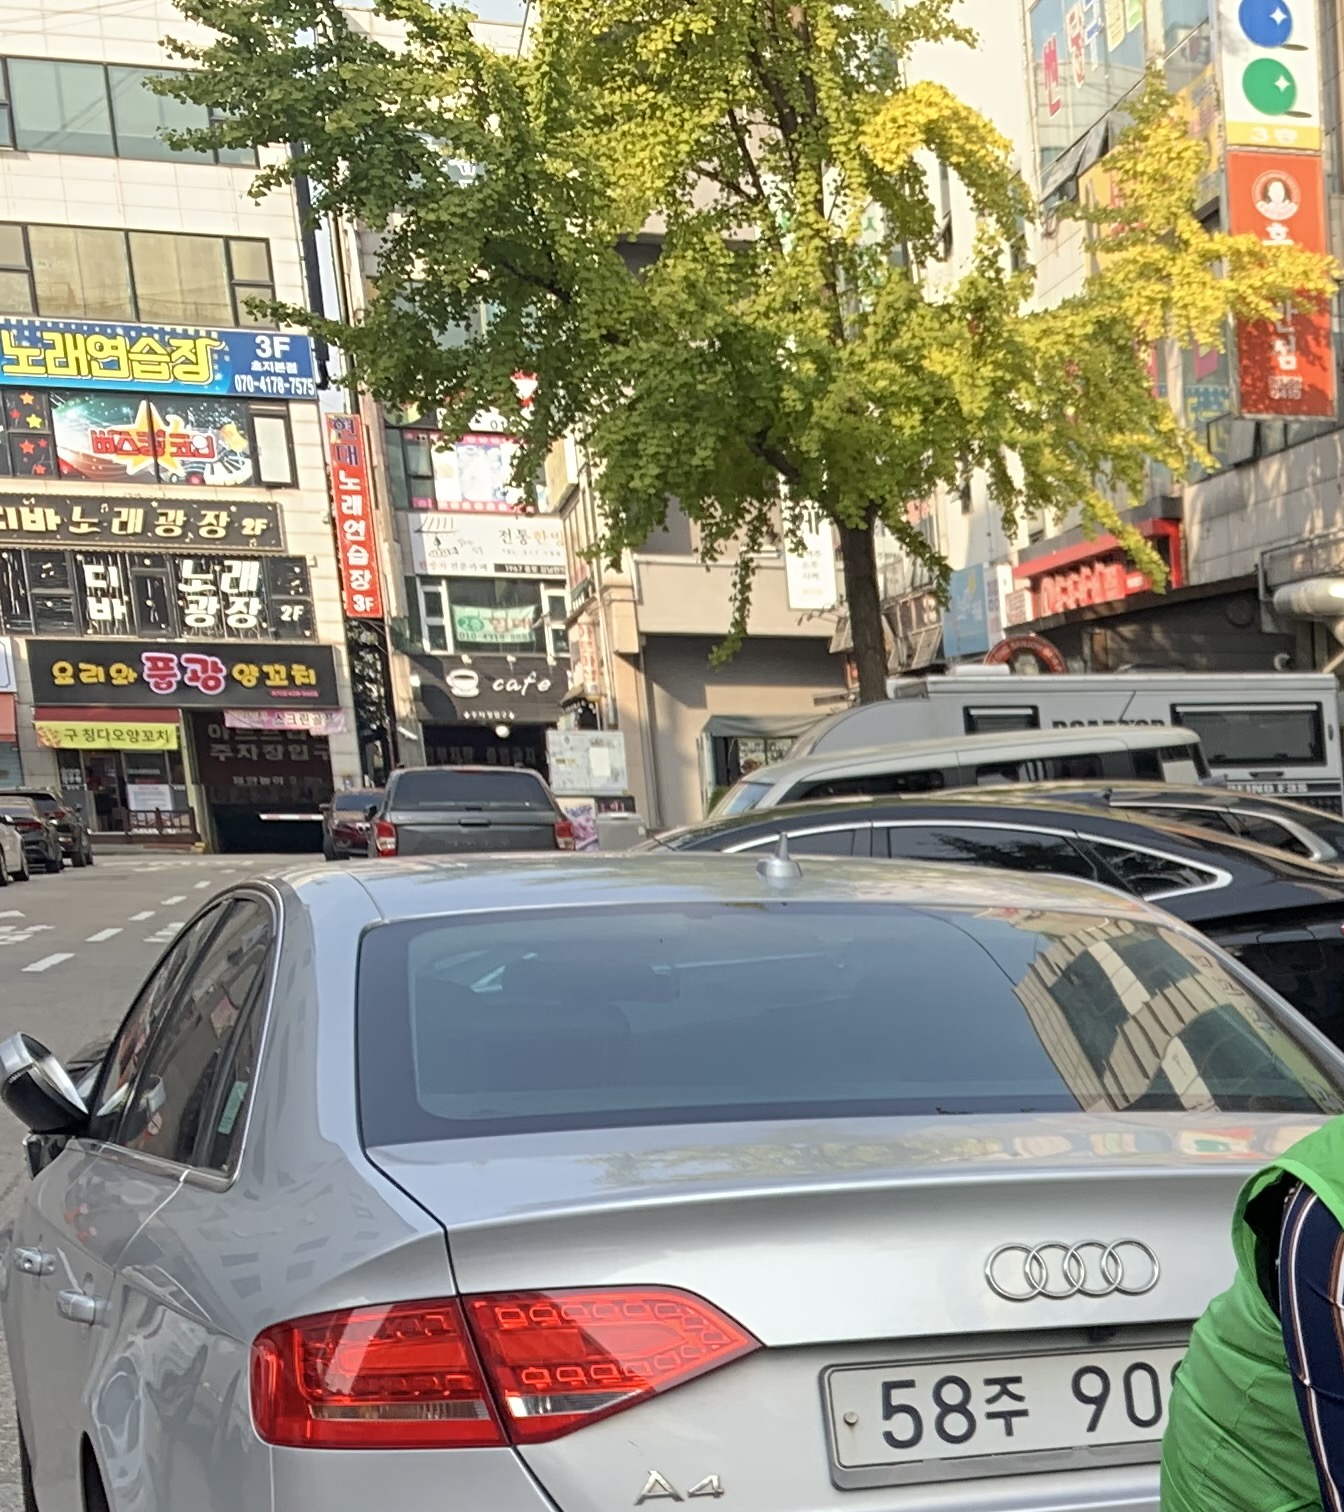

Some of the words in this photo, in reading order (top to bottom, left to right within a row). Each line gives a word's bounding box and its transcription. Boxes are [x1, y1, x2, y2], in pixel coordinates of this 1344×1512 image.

[0, 329, 227, 385] 노래연습장
[254, 335, 290, 359] 3F
[241, 517, 268, 537] 2F
[338, 469, 374, 592] 노래연습장
[280, 604, 304, 622] 2F
[352, 595, 375, 613] 3F
[51, 660, 138, 687] 요리와
[231, 662, 318, 688] 양꼬치
[492, 670, 552, 697] cafe
[81, 727, 170, 743] 칭다오양꼬치
[881, 1374, 1031, 1451] 58주
[1071, 1360, 1182, 1434] 90
[634, 1470, 725, 1506] A4
